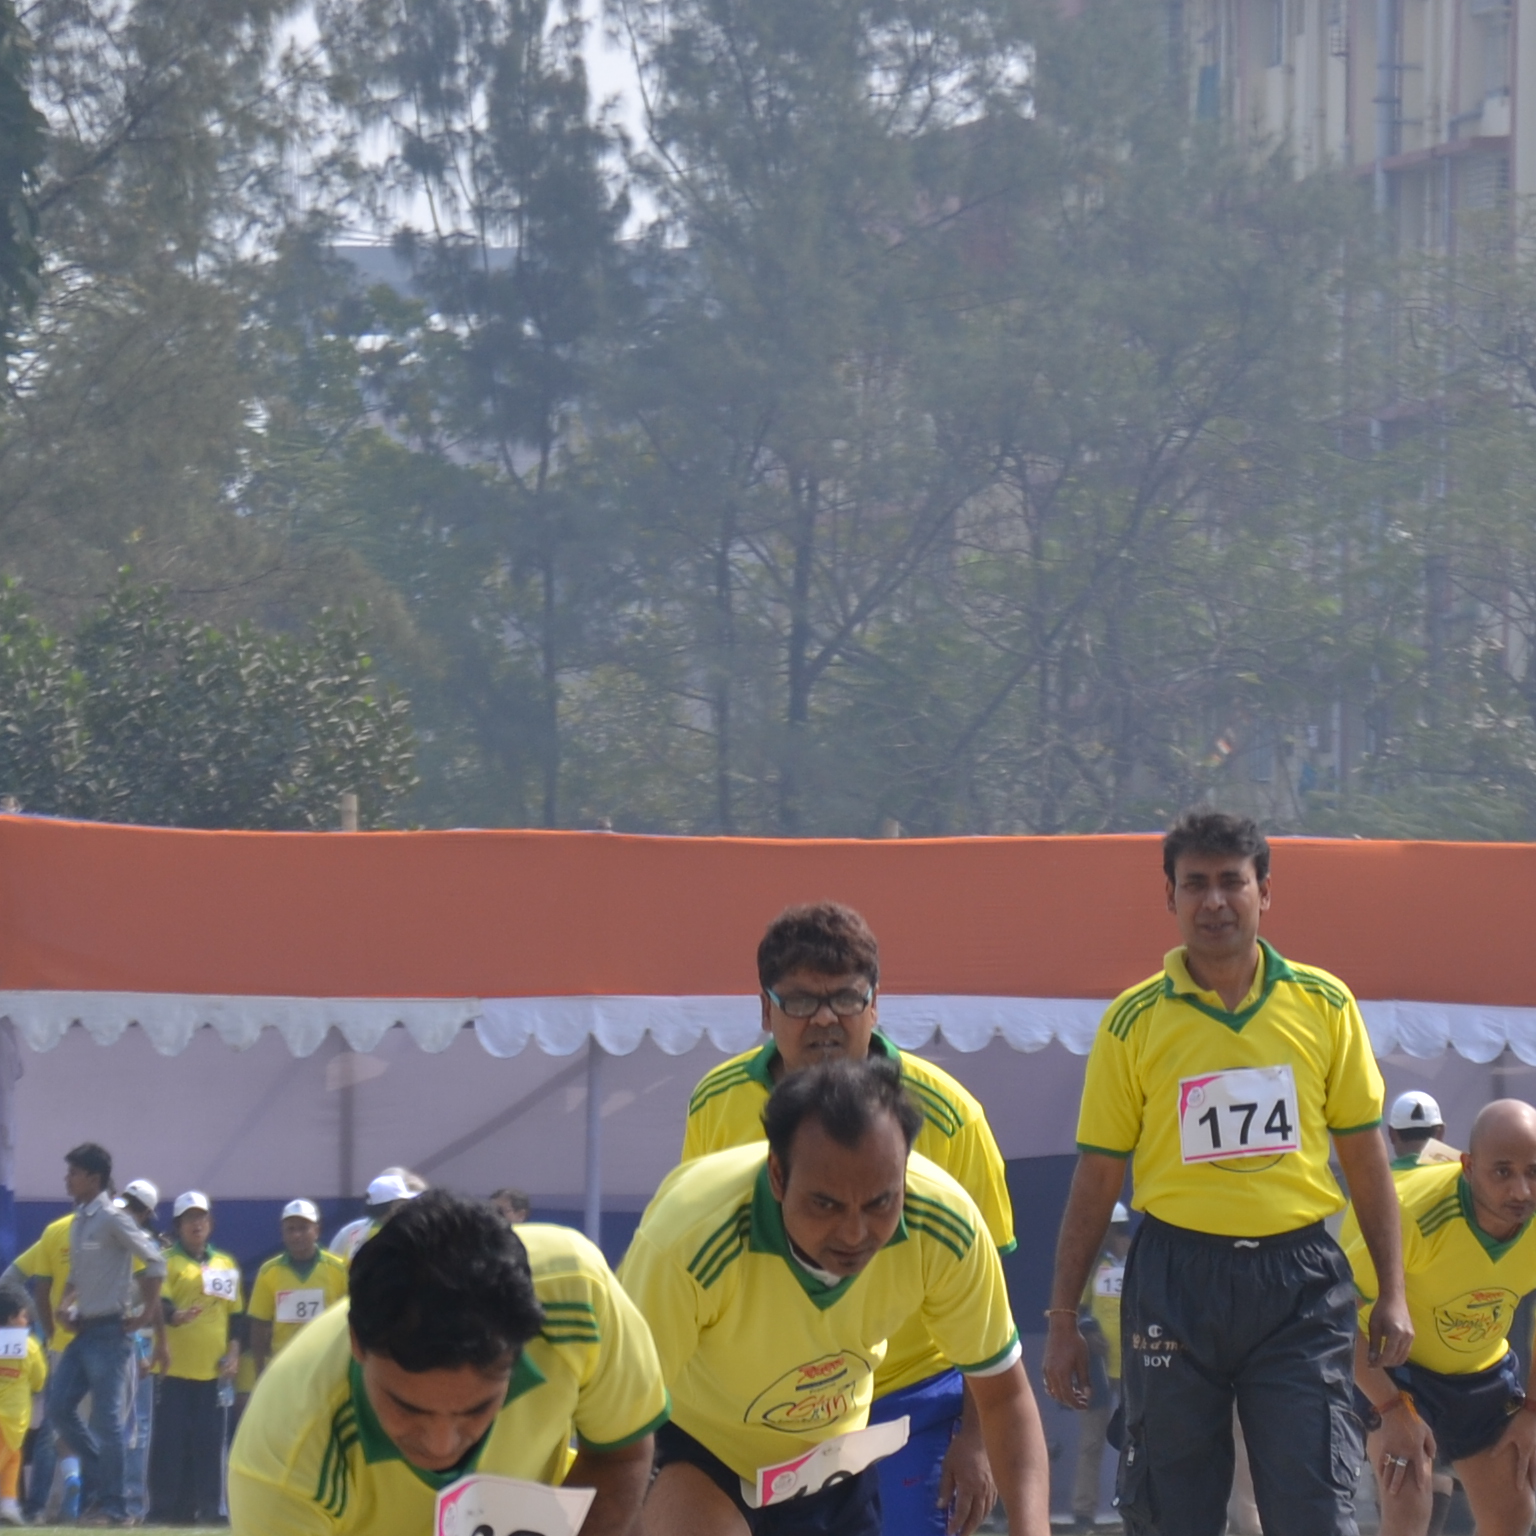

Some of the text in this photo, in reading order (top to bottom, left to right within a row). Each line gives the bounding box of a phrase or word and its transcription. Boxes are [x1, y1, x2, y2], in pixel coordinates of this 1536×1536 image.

[1198, 1098, 1293, 1149] 174
[211, 1277, 233, 1294] 63
[296, 1301, 320, 1317] 87
